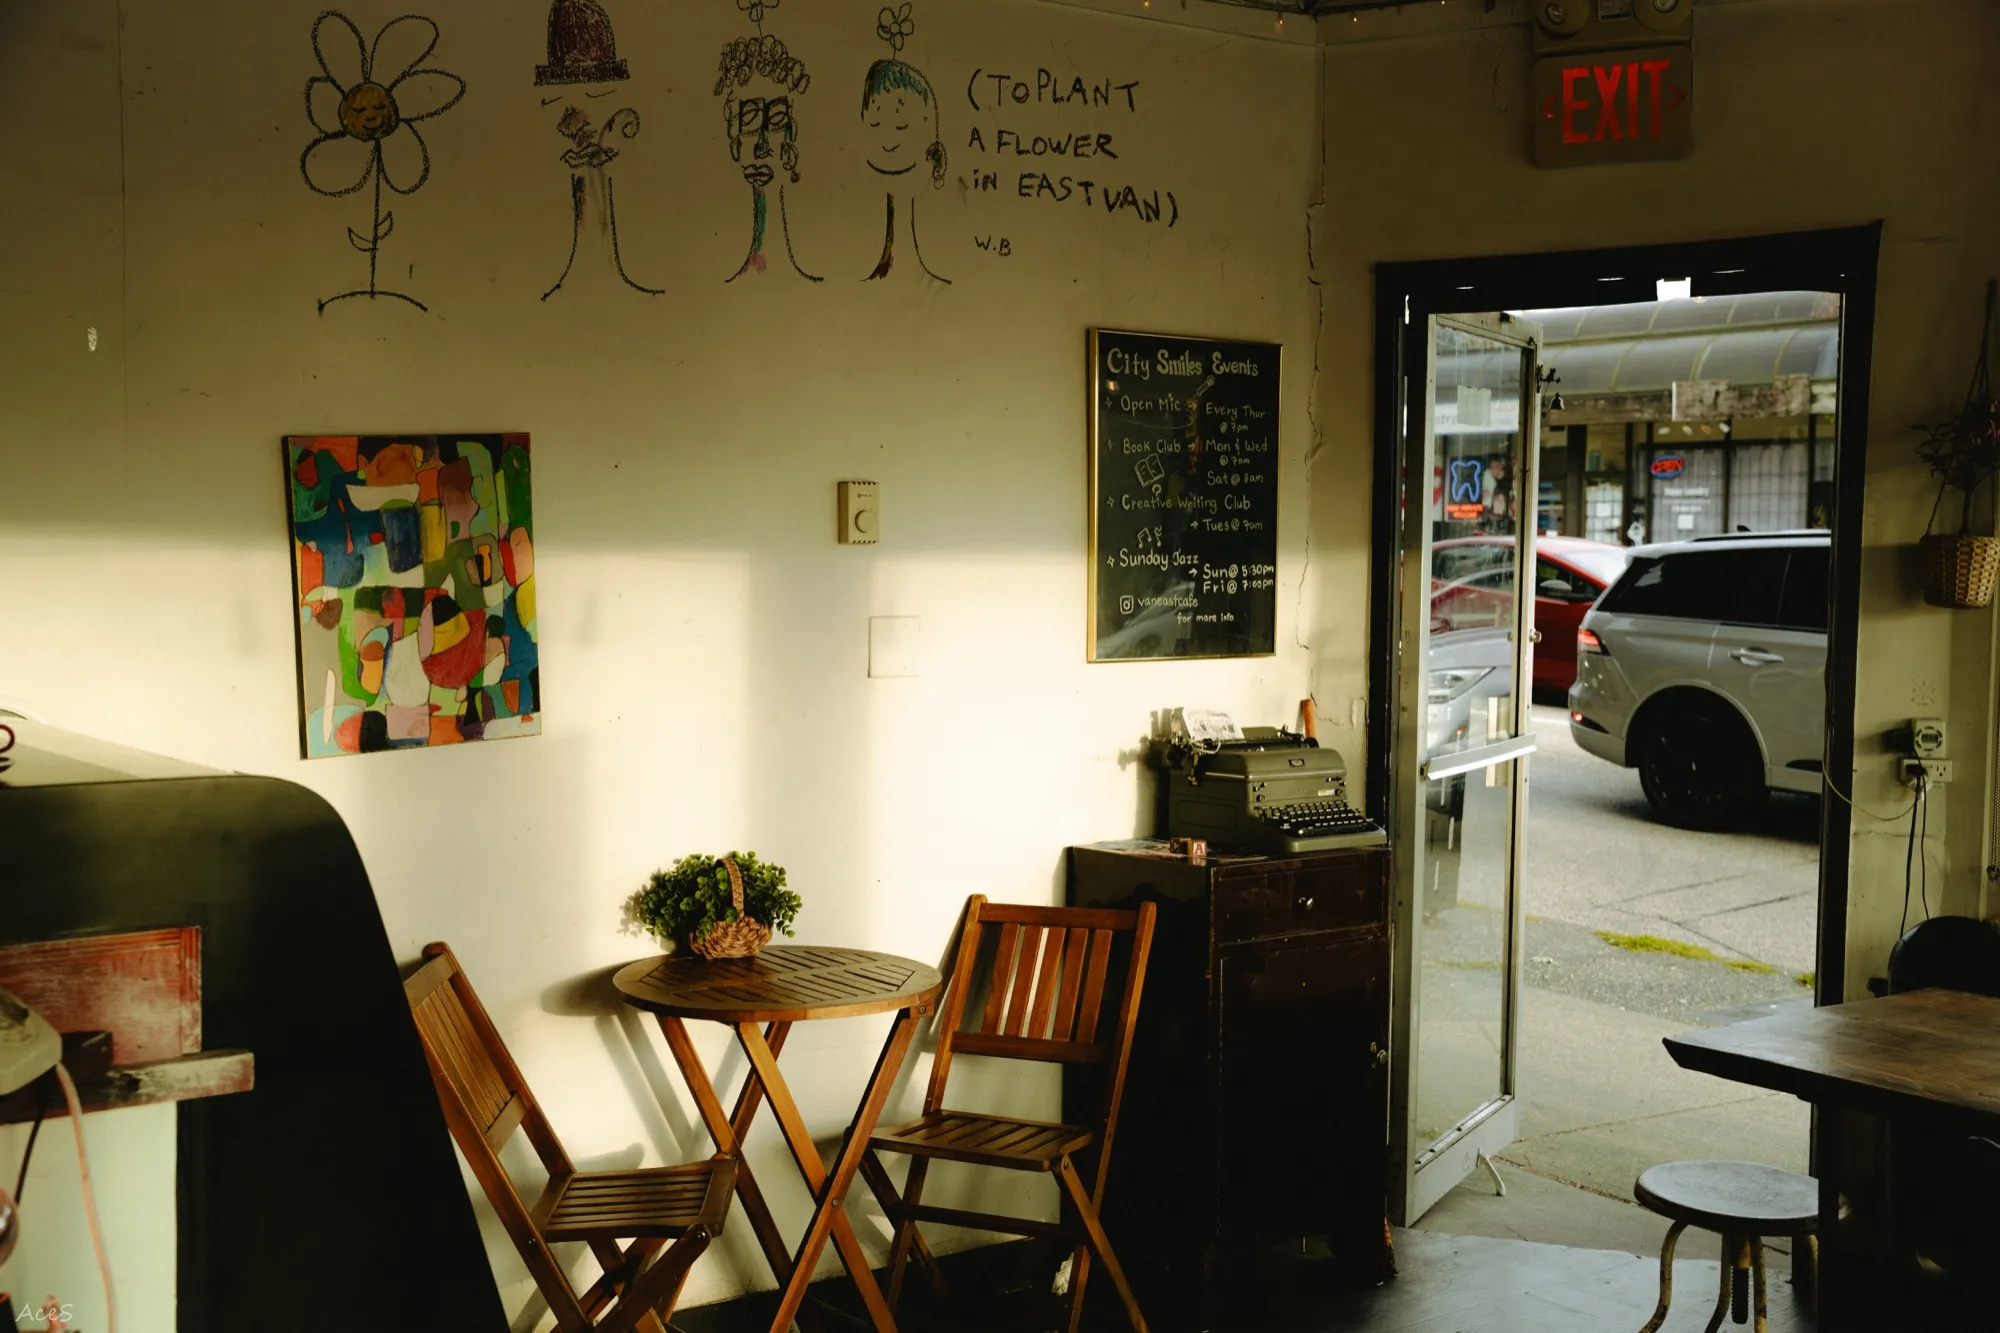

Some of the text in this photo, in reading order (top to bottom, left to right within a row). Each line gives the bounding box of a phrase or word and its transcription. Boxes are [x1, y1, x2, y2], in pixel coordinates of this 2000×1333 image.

[1562, 59, 1671, 145] EXIT
[968, 126, 1119, 160] A FLOWER
[1106, 347, 1259, 381] City Smiles Events
[1119, 395, 1266, 421] Open Mic Every Thur
[1123, 437, 1151, 454] Book
[1156, 438, 1182, 454] Club
[1205, 438, 1231, 452] Mon
[1244, 436, 1268, 452] Wed
[1121, 494, 1251, 514] Creative Writing Club
[1119, 548, 1199, 571] Sunday Jazz
[1137, 593, 1199, 608] vaneastcafe
